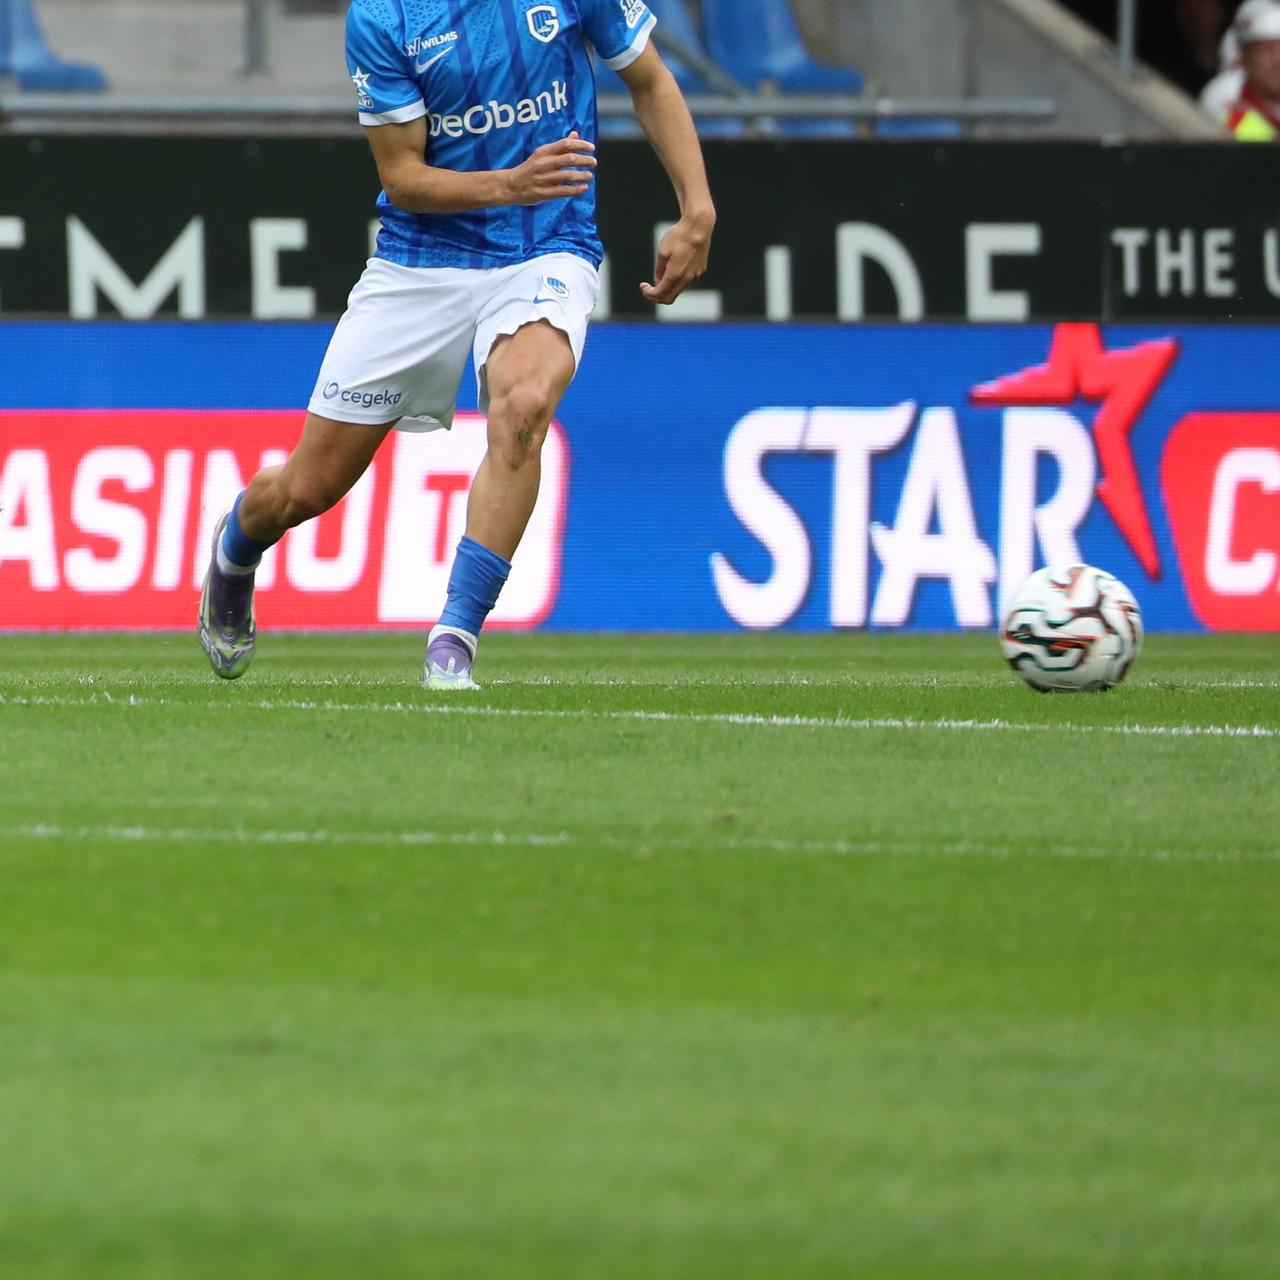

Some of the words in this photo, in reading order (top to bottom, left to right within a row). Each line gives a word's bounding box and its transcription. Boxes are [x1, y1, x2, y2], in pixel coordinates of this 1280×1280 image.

[421, 31, 458, 50] WILMS
[1109, 227, 1237, 298] THE
[708, 399, 1097, 629] STAR
